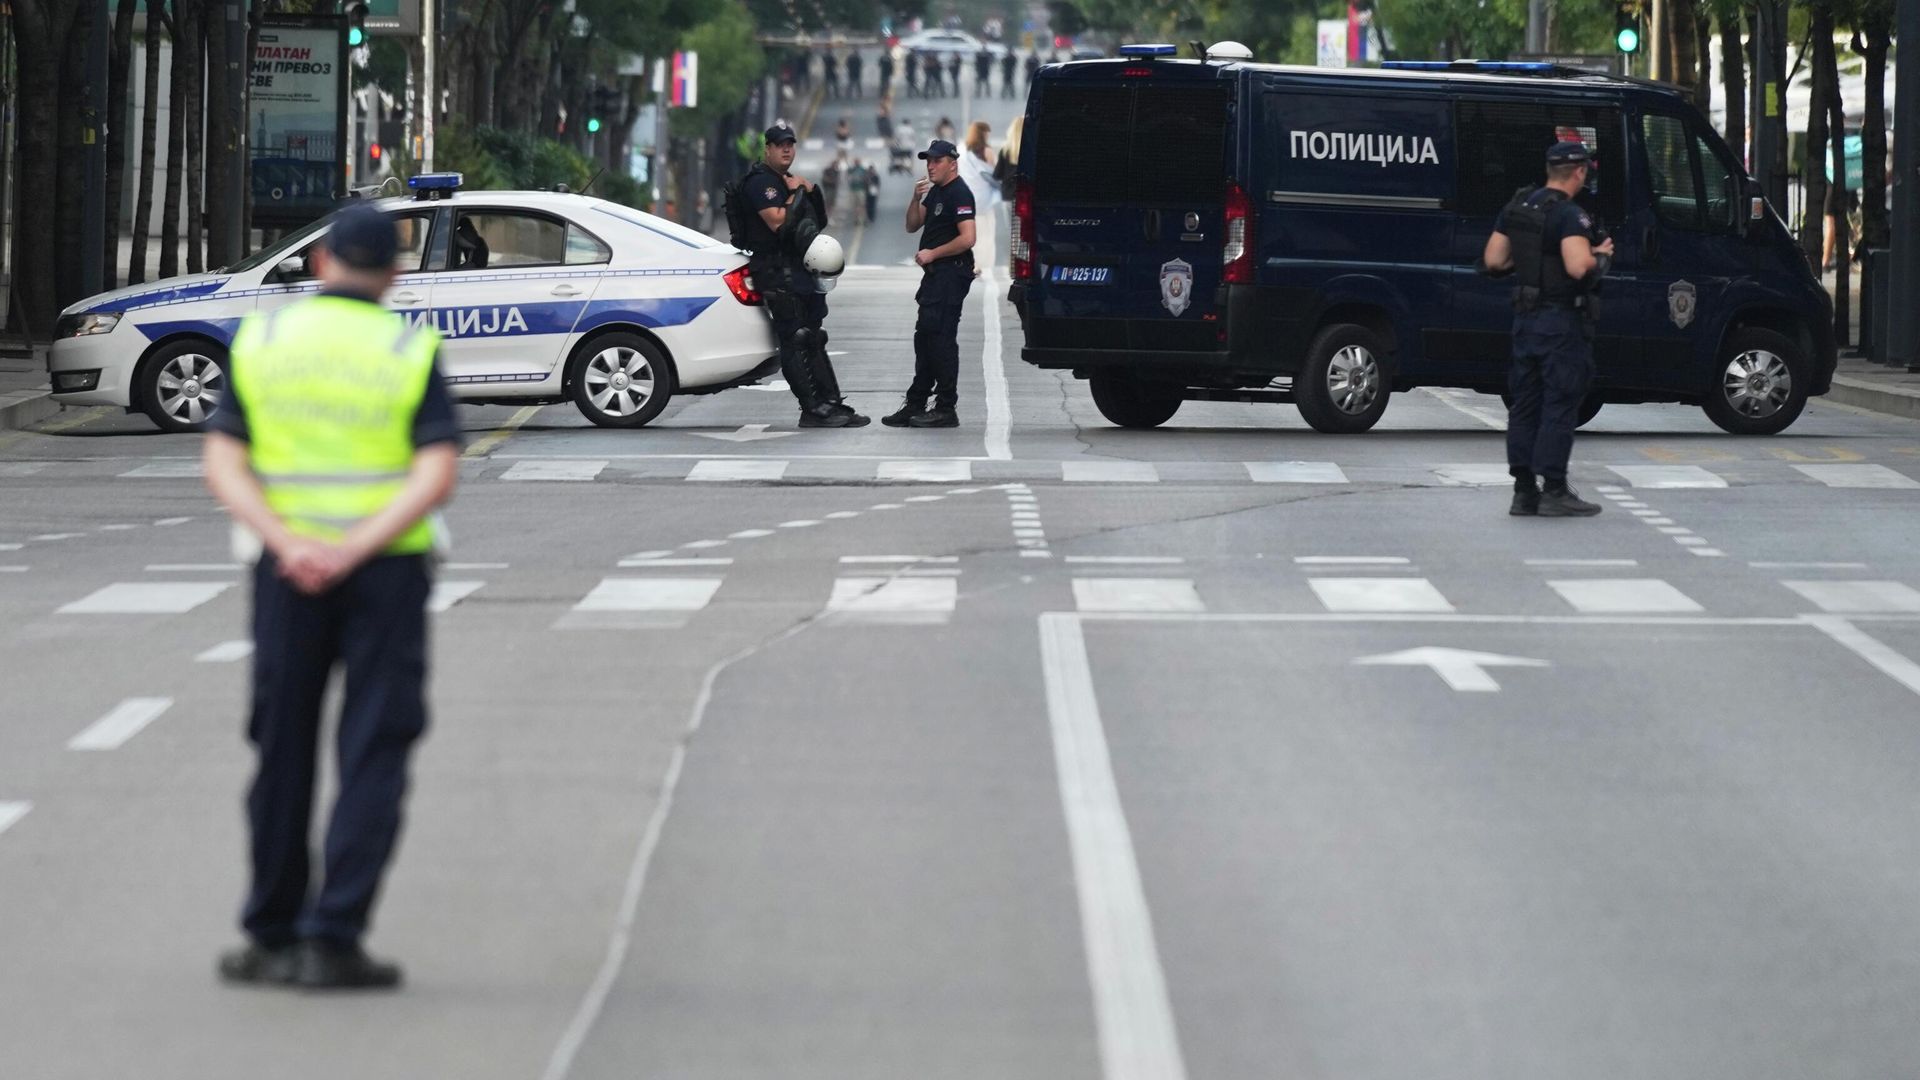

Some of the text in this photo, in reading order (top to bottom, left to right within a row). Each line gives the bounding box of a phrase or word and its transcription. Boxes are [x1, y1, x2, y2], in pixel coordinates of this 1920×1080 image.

[256, 47, 311, 59] ПЛАТАН
[274, 62, 332, 75] ПРЕВОЗ
[1290, 130, 1439, 168] ПОЛИЦИЈА
[391, 306, 529, 338] ИЦИЈА
